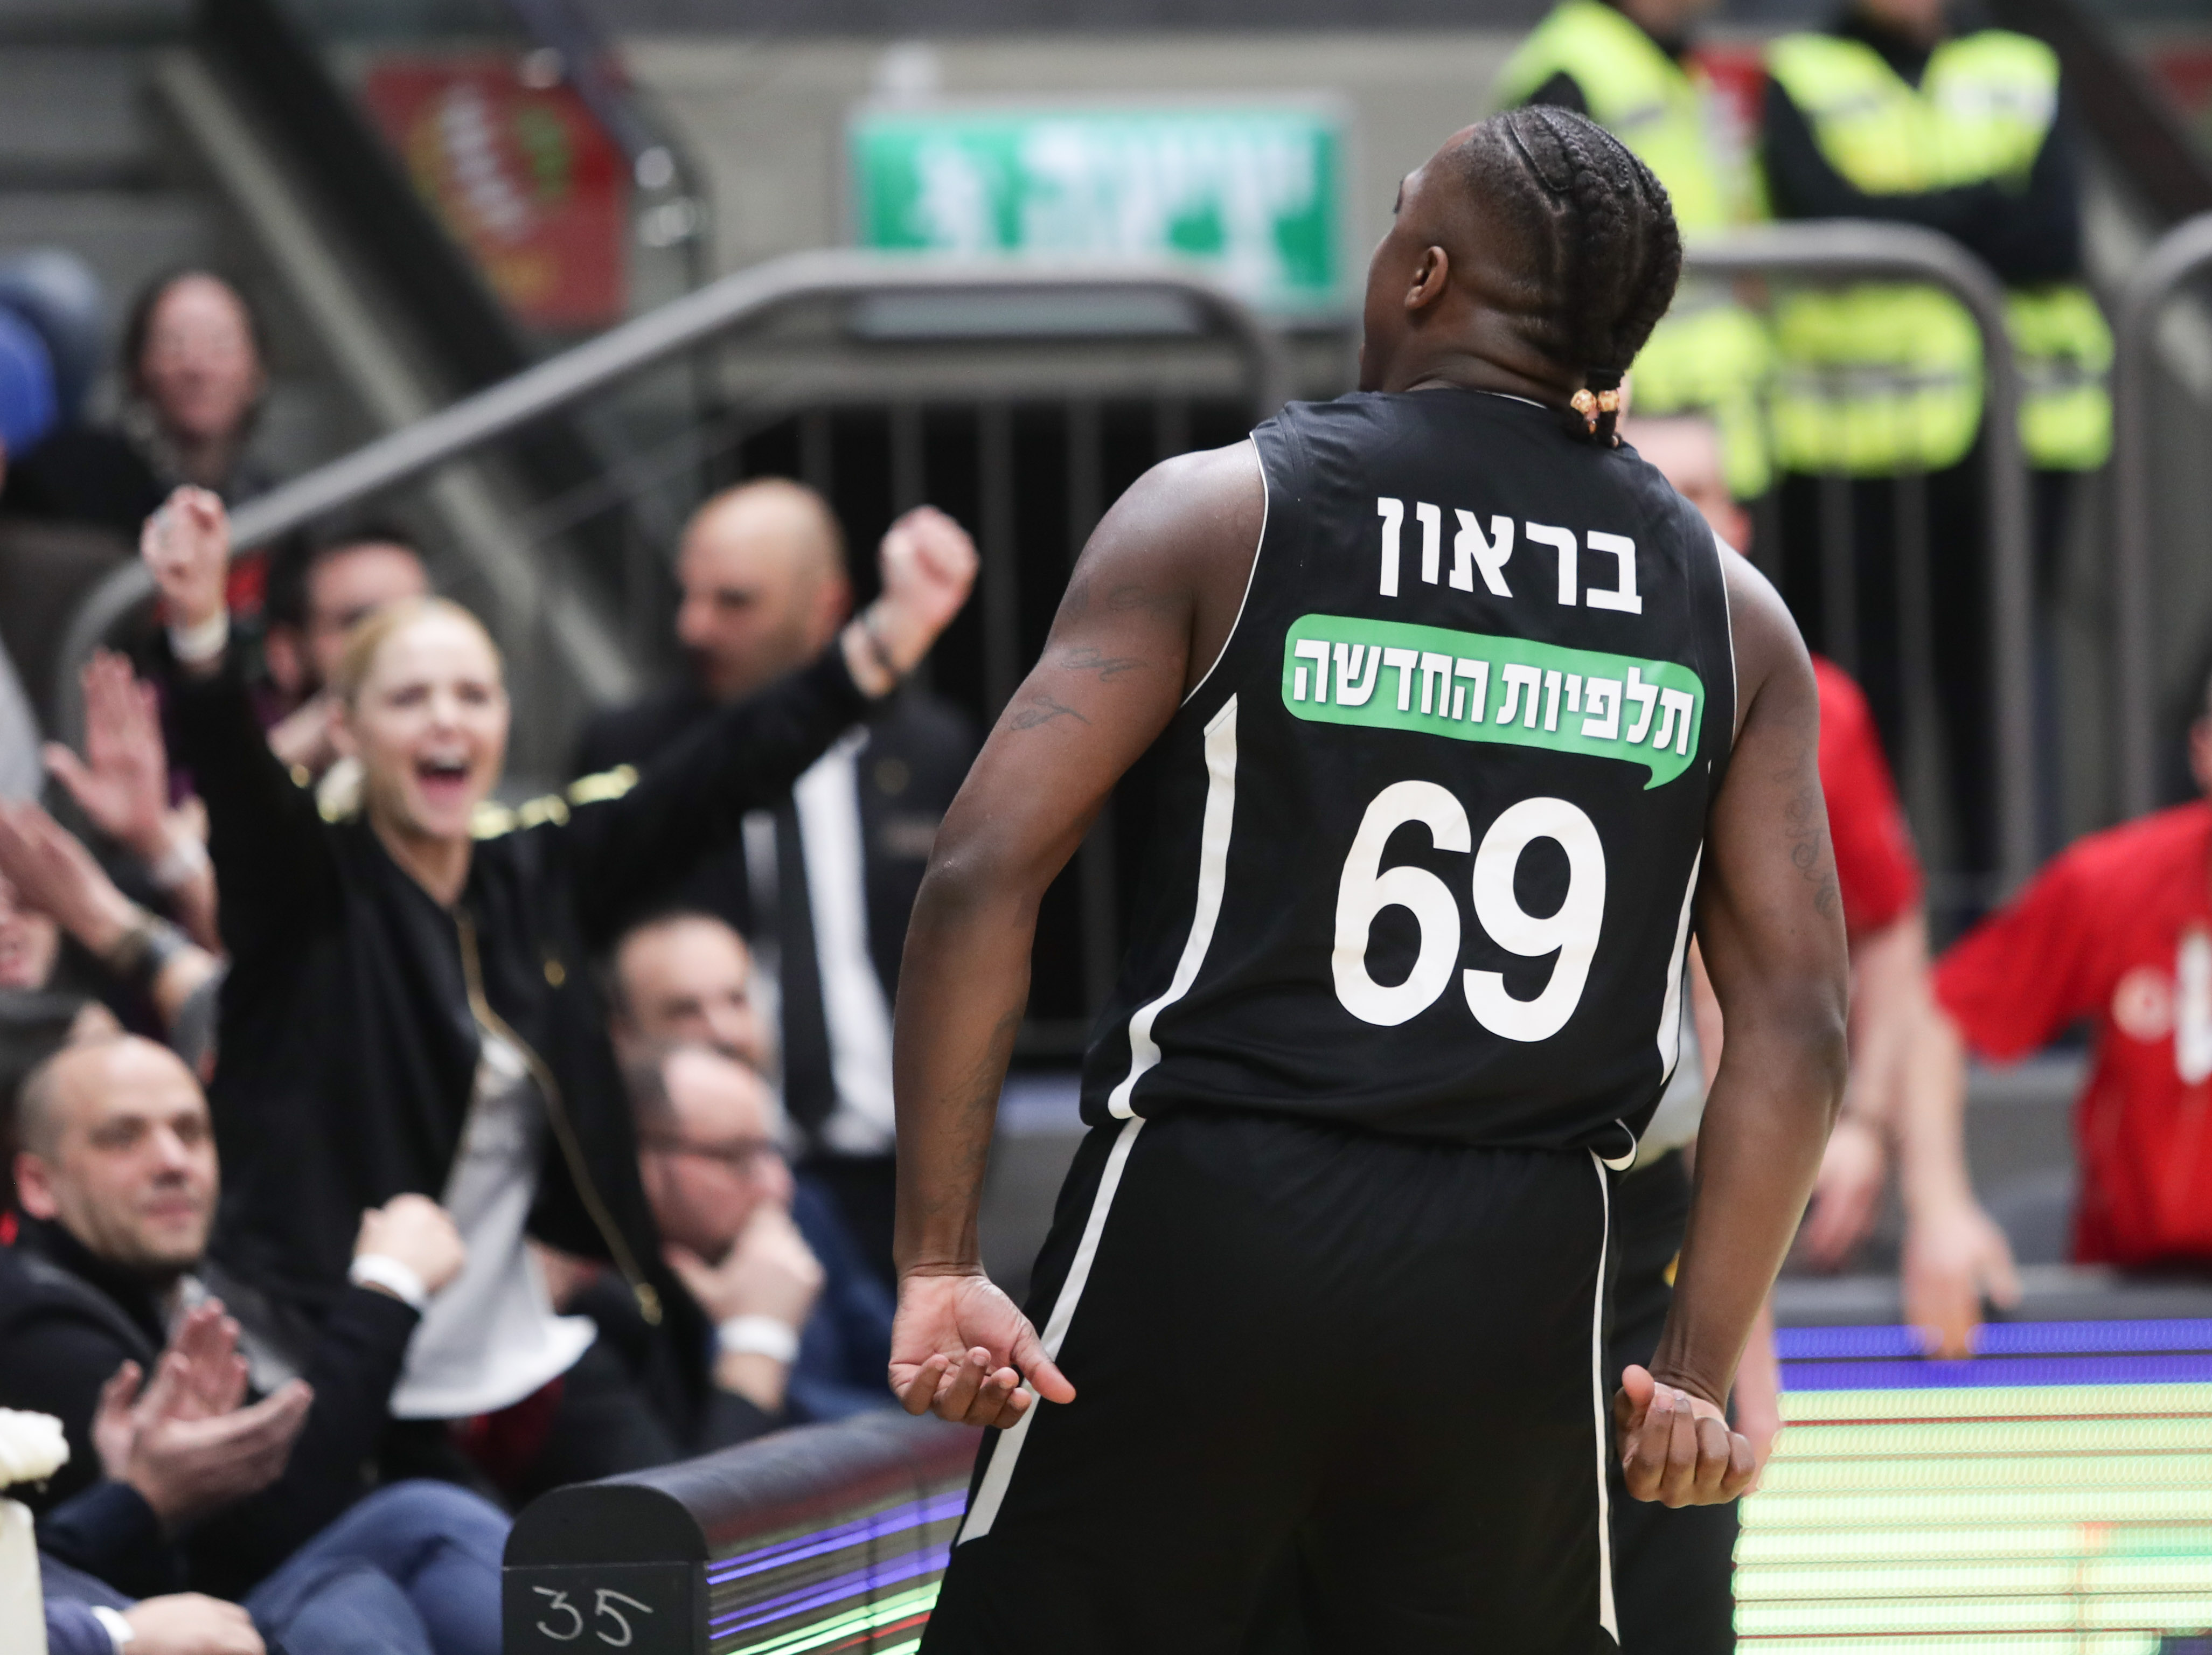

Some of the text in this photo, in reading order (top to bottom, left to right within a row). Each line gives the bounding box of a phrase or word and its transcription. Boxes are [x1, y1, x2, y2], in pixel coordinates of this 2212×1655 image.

[1377, 497, 1643, 615] בראון
[1293, 639, 1694, 756] תלפיות החדשה
[1331, 780, 1606, 1042] 69
[532, 1586, 653, 1647] 35
